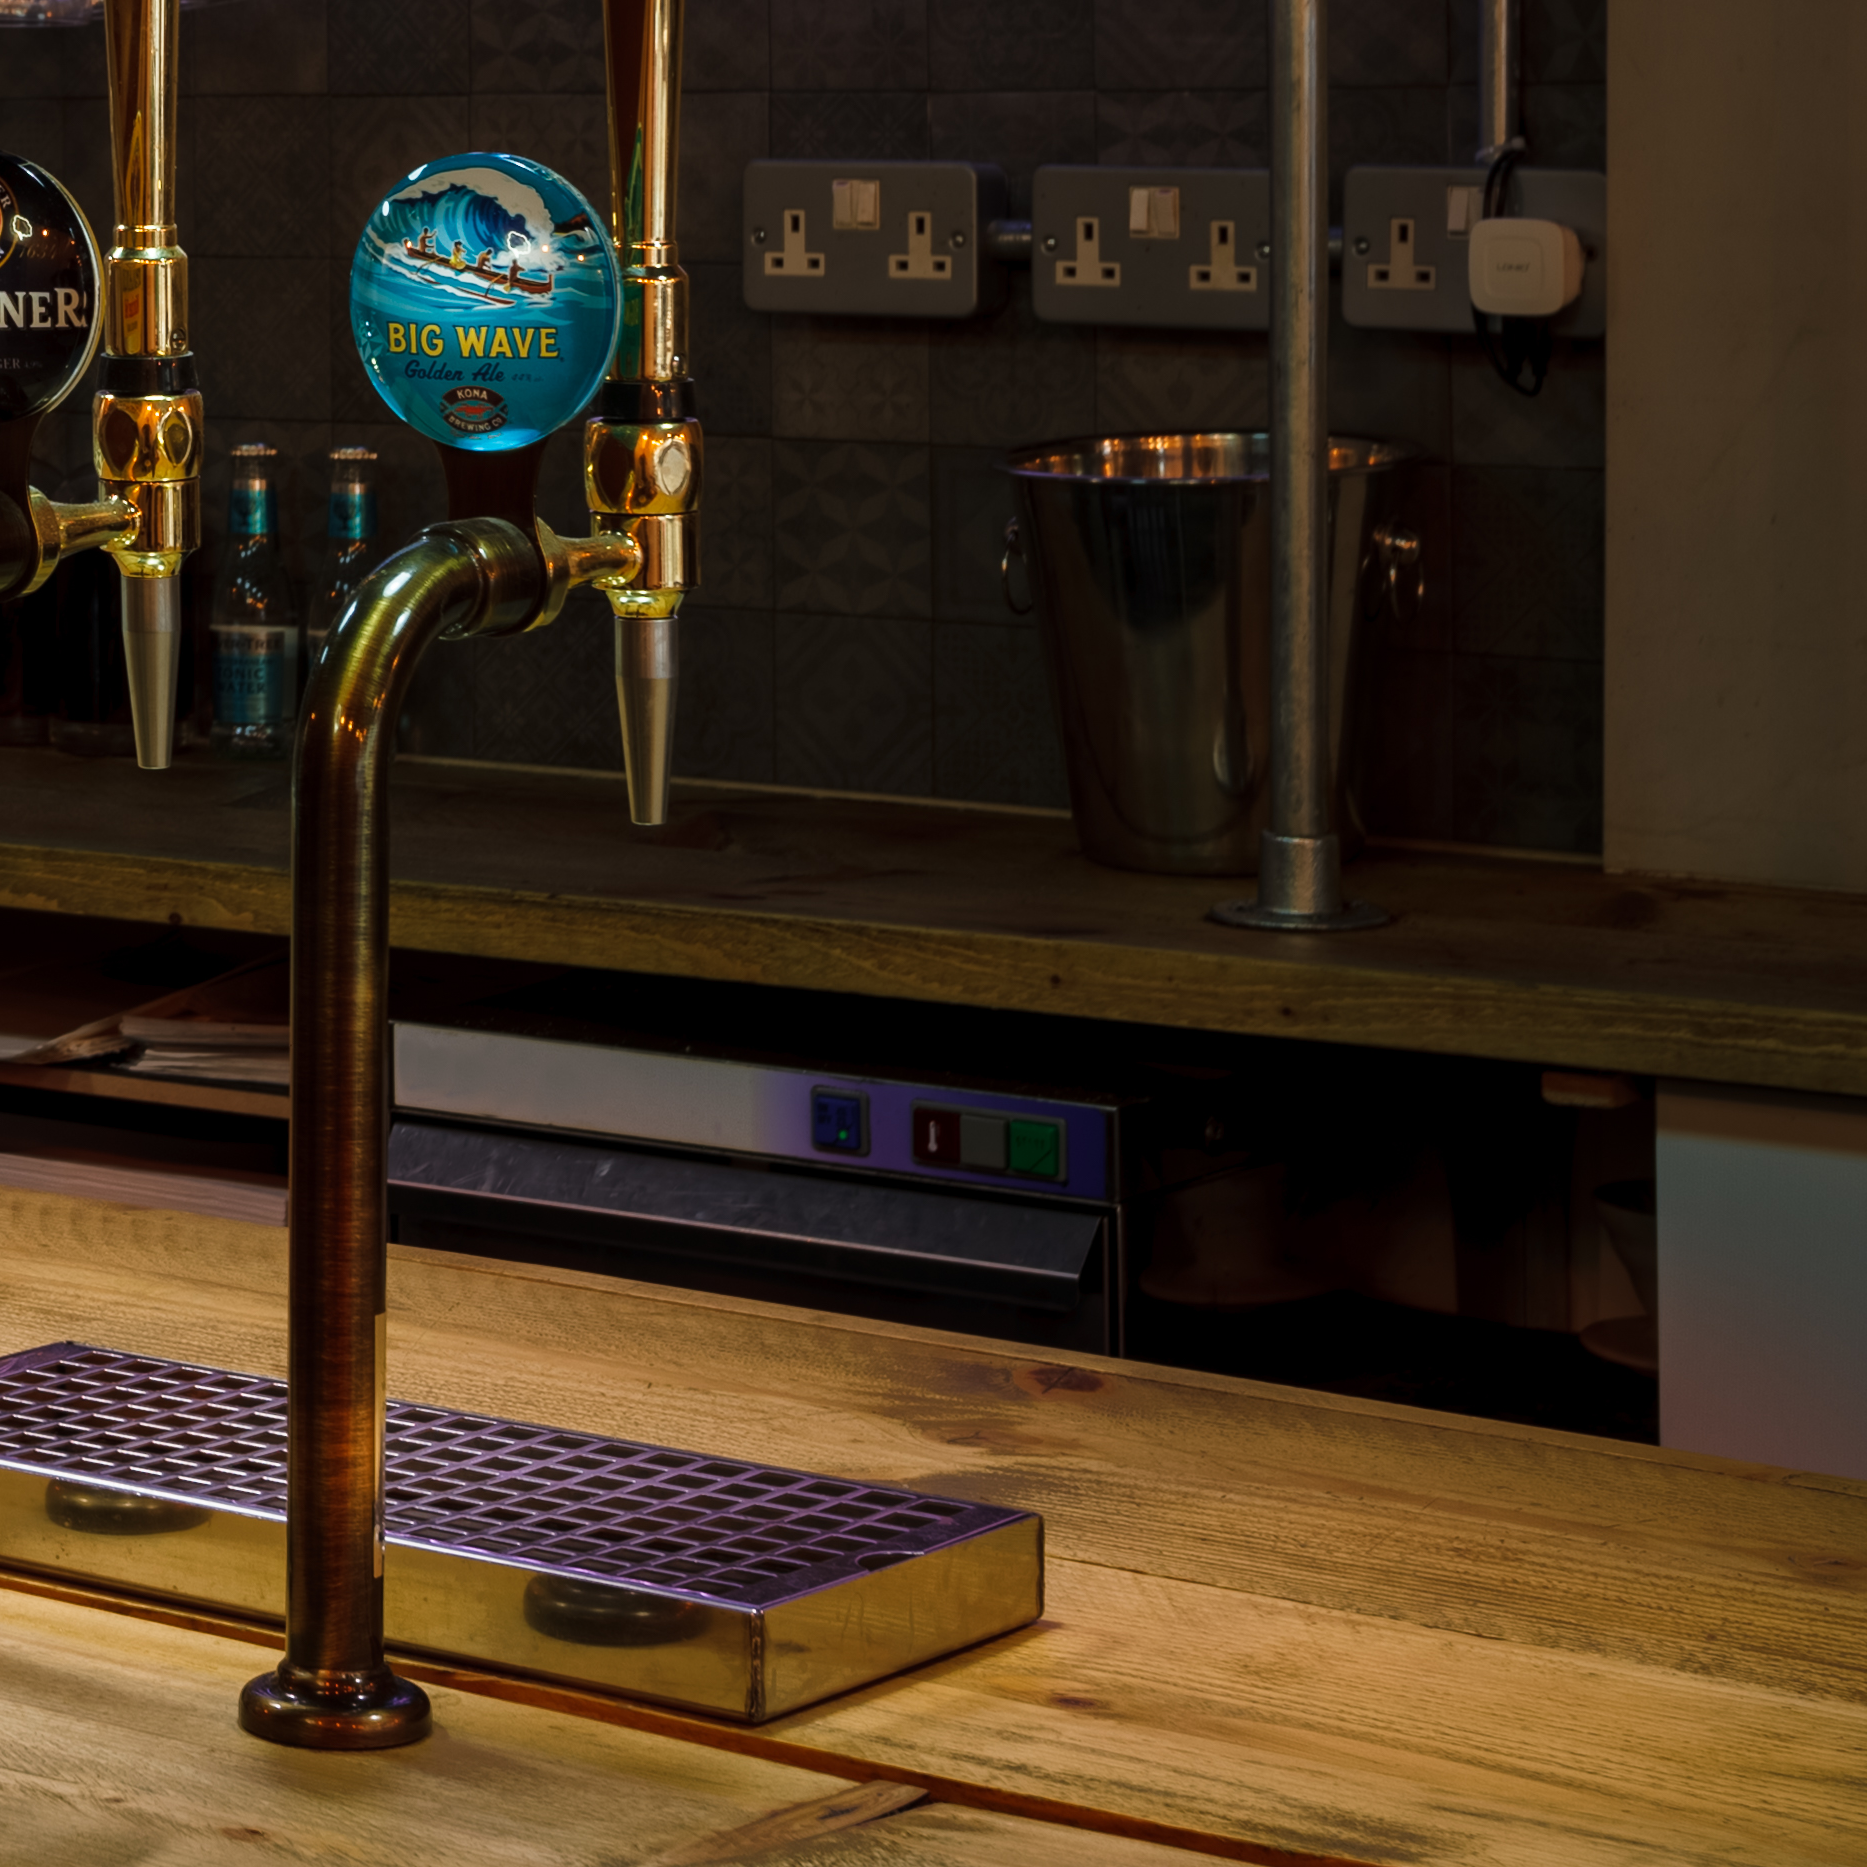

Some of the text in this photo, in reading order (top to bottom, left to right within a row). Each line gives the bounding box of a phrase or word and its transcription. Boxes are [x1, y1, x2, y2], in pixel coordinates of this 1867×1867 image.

[386, 321, 560, 359] BIG WAVE
[405, 359, 506, 384] Golden Ale
[456, 388, 489, 401] KONA
[448, 415, 492, 433] BREWING
